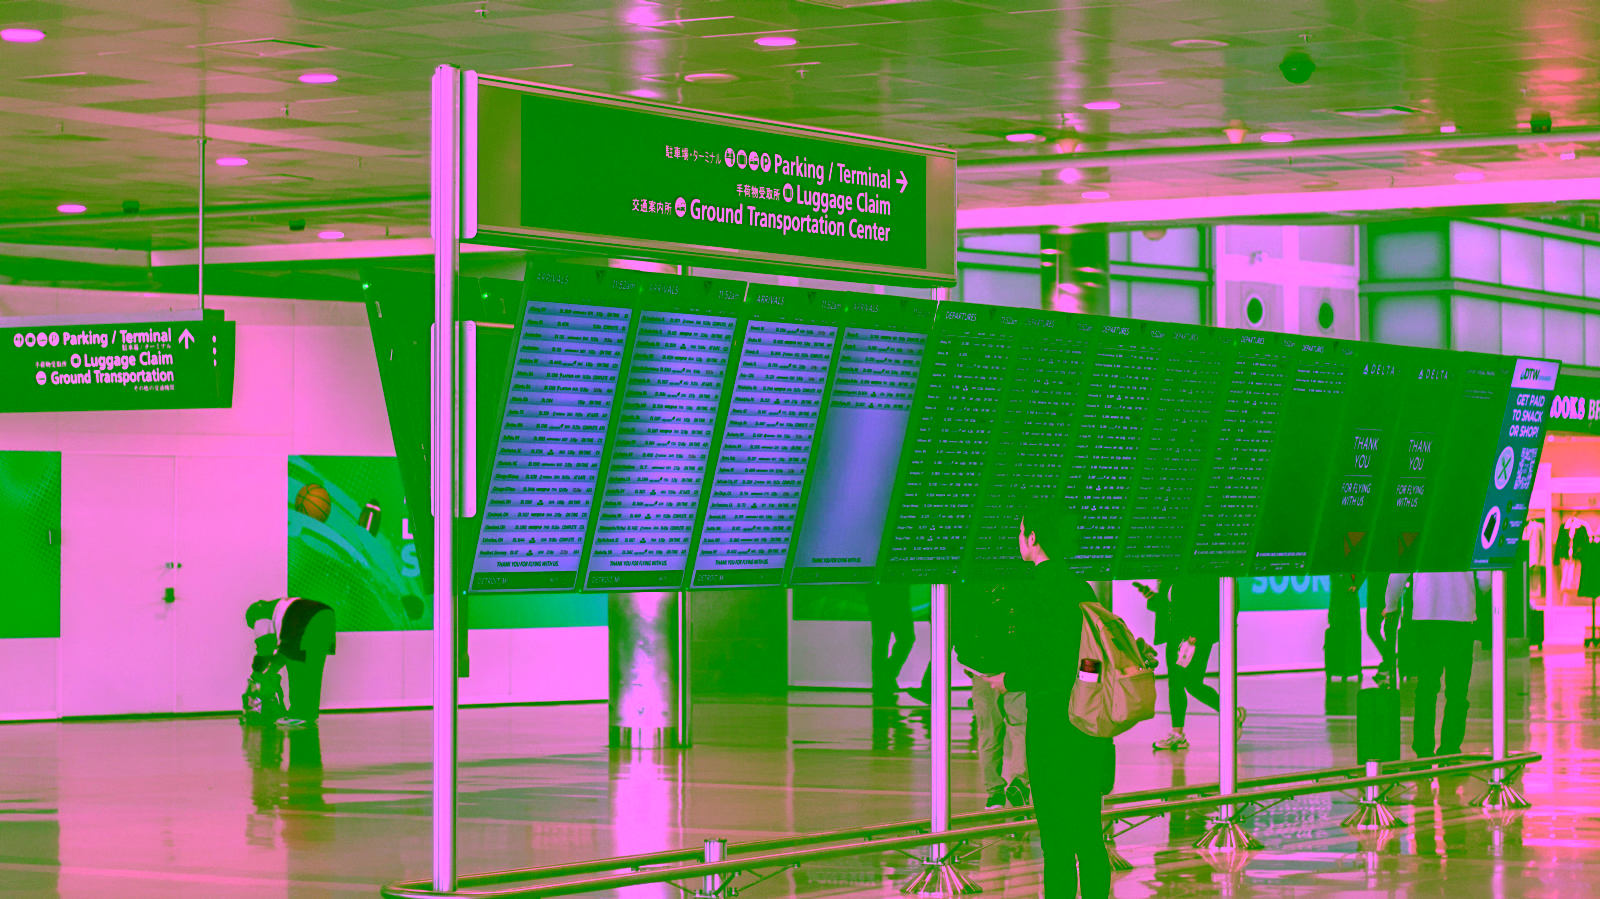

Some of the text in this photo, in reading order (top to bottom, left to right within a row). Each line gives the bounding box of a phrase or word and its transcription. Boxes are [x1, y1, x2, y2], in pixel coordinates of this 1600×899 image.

[774, 154, 824, 185] Parking
[837, 162, 891, 189] Terminal
[736, 184, 780, 201] 手荷物受取所
[797, 184, 891, 215] Luggage Claim
[632, 198, 672, 216] 交通案内所
[690, 199, 891, 242] Ground Transportation Center
[536, 273, 570, 284] ARRIVALS
[648, 286, 679, 296] ARRIVALS
[756, 295, 785, 305] ARRIVALS
[853, 304, 880, 313] ARRIVALS
[945, 311, 977, 322] DEPARTURES
[1102, 326, 1130, 335] DEPARTURES
[62, 332, 108, 348] Parking
[120, 327, 172, 344] Terminal
[1240, 336, 1265, 345] DEPARTURES
[84, 350, 173, 370] Luggage Claim
[1370, 364, 1395, 375] DELTA
[1425, 368, 1448, 380] DELTA
[1524, 368, 1540, 380] DTW
[50, 368, 174, 386] Ground Transportation
[1516, 394, 1545, 407] GET PAID
[1550, 395, 1585, 420] OOKS
[1512, 409, 1543, 422] TO SNACK
[1509, 424, 1539, 438] OR SHOP!
[1353, 436, 1379, 451] THANK
[1408, 439, 1433, 453] THANK
[1355, 455, 1370, 468] YOU
[1410, 457, 1424, 471] YOU
[1341, 483, 1371, 494] FOR FLYING
[1396, 485, 1424, 495] FOR FLYING
[1341, 496, 1364, 506] WITH US
[1396, 497, 1418, 507] WITH US
